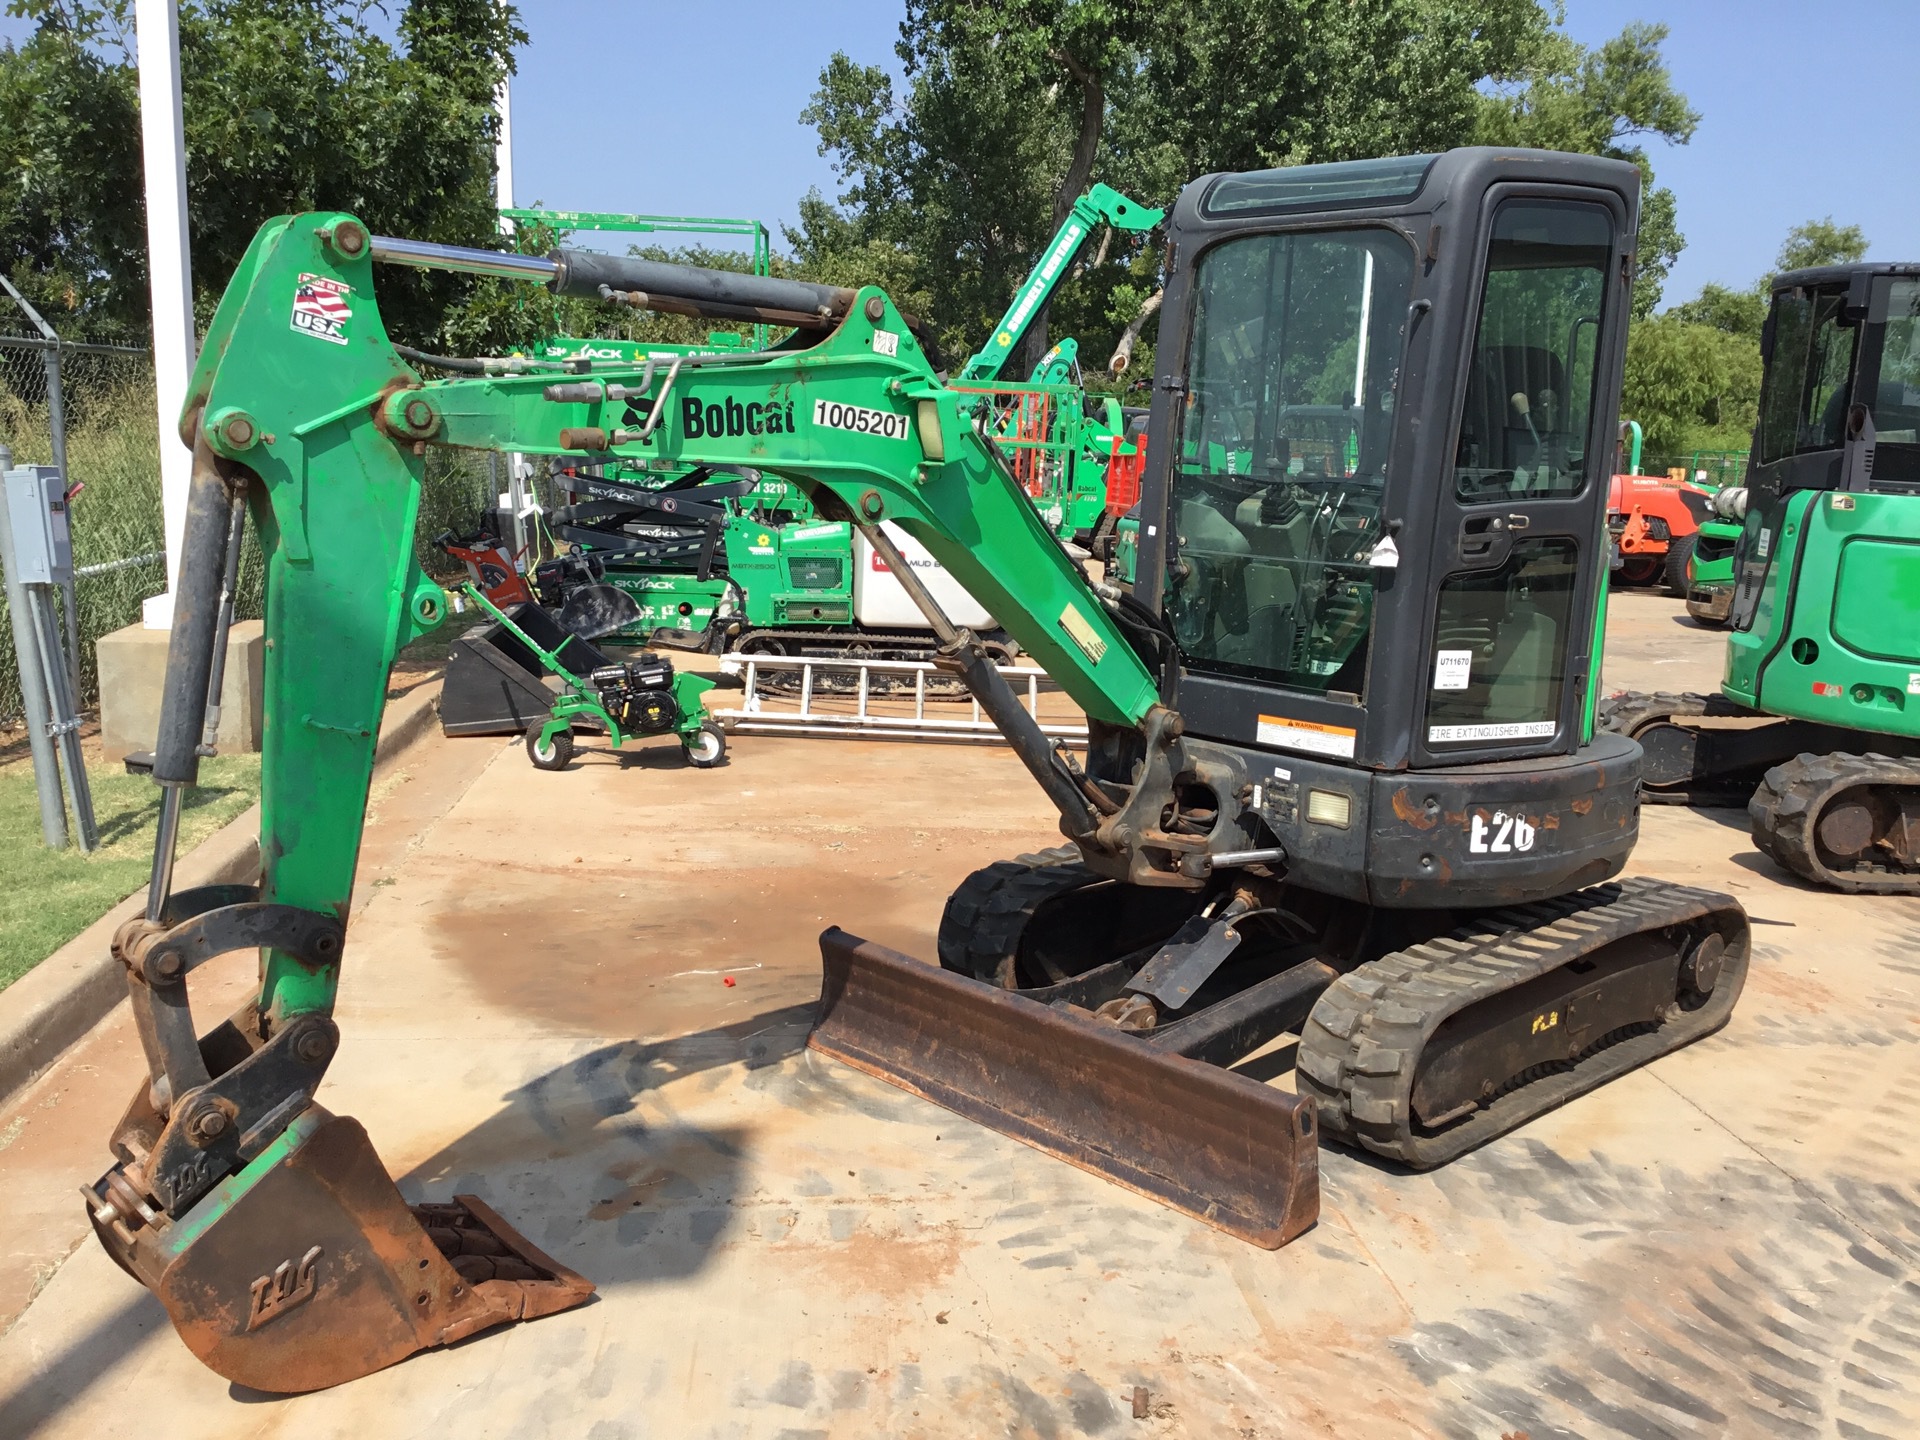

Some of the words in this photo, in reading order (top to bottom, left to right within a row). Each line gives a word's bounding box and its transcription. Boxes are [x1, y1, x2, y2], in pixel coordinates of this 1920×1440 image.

[326, 282, 336, 291] IN
[1006, 277, 1046, 333] SUNBELT
[1040, 224, 1081, 281] RENTALS
[295, 311, 344, 338] USA
[681, 395, 795, 440] Bobcat
[817, 401, 907, 439] 1005201
[588, 486, 635, 502] SKYJACK
[637, 528, 679, 537] SKYJACK
[614, 577, 676, 590] SKYJACK
[1294, 721, 1324, 731] WARNING
[1430, 728, 1452, 739] FIRE
[1456, 726, 1519, 738] EXTINGUISHER
[1524, 723, 1554, 735] INSIDE
